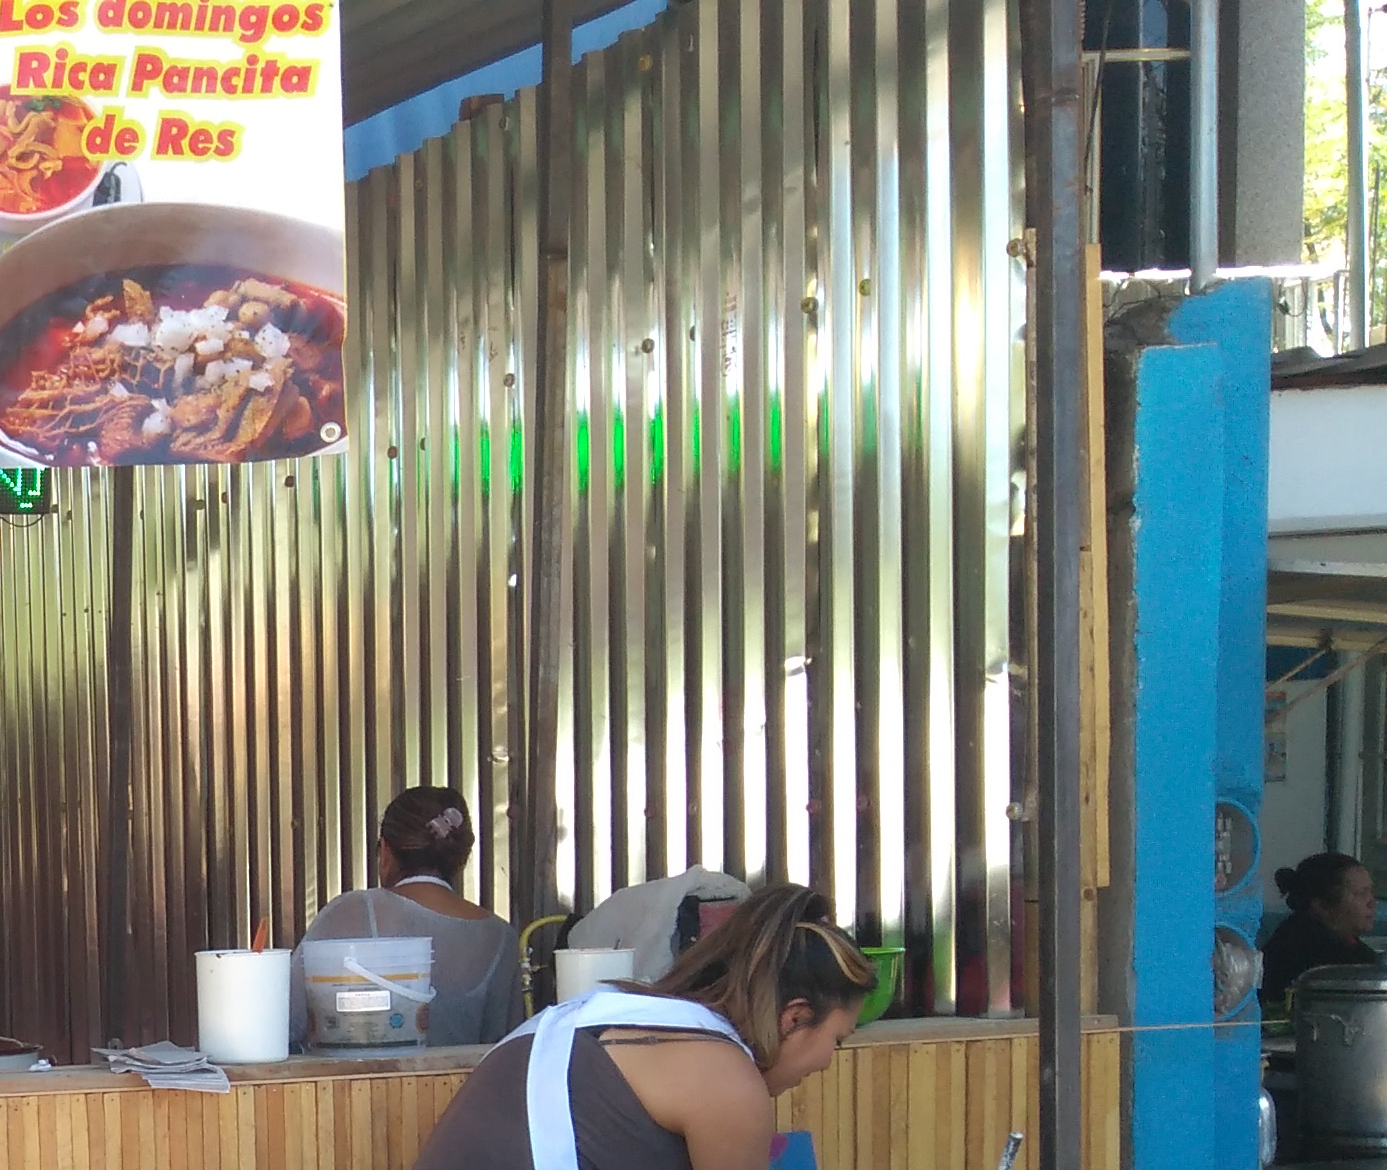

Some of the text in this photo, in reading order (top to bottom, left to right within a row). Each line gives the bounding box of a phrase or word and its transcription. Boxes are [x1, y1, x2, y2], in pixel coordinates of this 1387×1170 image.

[97, 0, 324, 43] domingos
[16, 48, 312, 94] Rica Pancita
[85, 114, 236, 157] de Res
